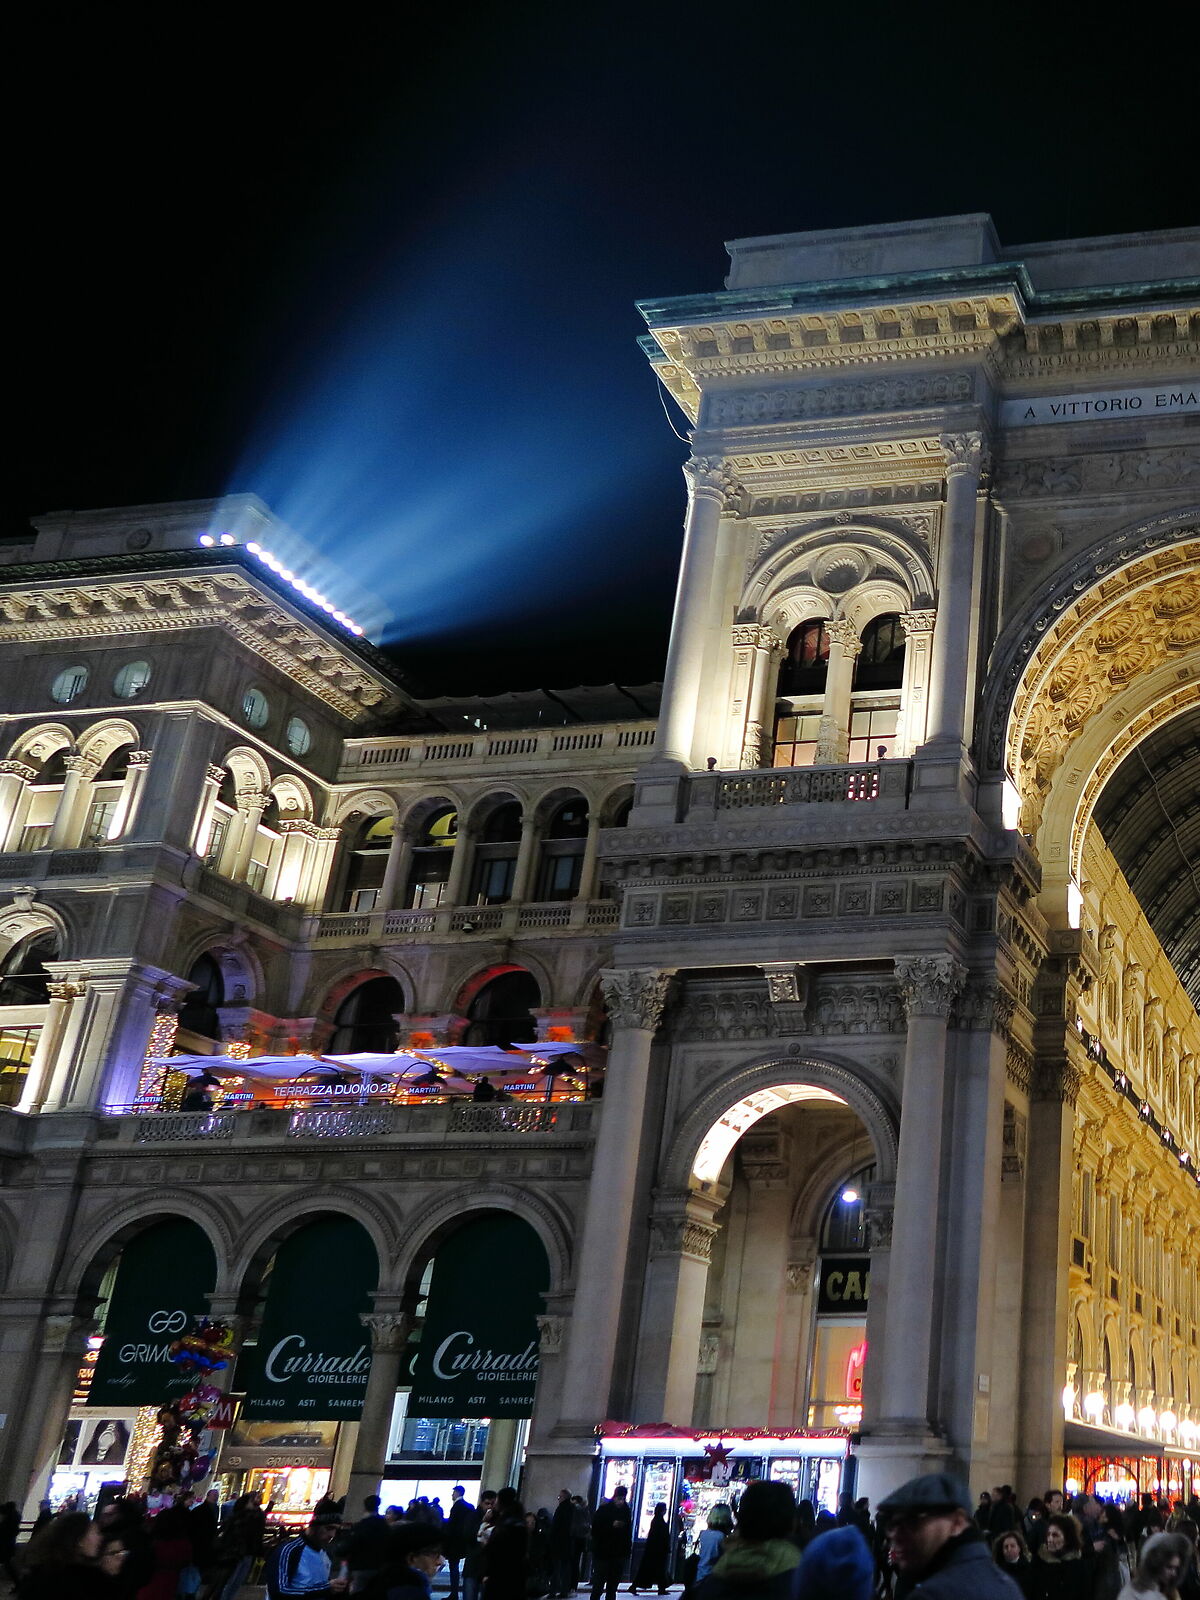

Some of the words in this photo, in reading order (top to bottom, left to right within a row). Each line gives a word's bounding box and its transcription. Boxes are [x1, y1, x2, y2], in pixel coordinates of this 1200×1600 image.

[1024, 406, 1036, 419] A
[1050, 396, 1143, 416] VITTORIO
[274, 1085, 333, 1097] TERRAZZA
[334, 1083, 379, 1095] DUOMO
[409, 1086, 440, 1094] MARTINI
[224, 1093, 254, 1101] MARTINI
[826, 1271, 872, 1301] CA
[265, 1334, 372, 1383] Currado
[432, 1331, 539, 1380] Currado
[307, 1374, 368, 1384] GIOIELLERIE
[477, 1372, 538, 1381] GIOIELLERIE
[250, 1399, 286, 1407] MILANO
[298, 1399, 316, 1407] ASTI
[418, 1396, 455, 1404] MILANO
[468, 1396, 487, 1404] ASTI
